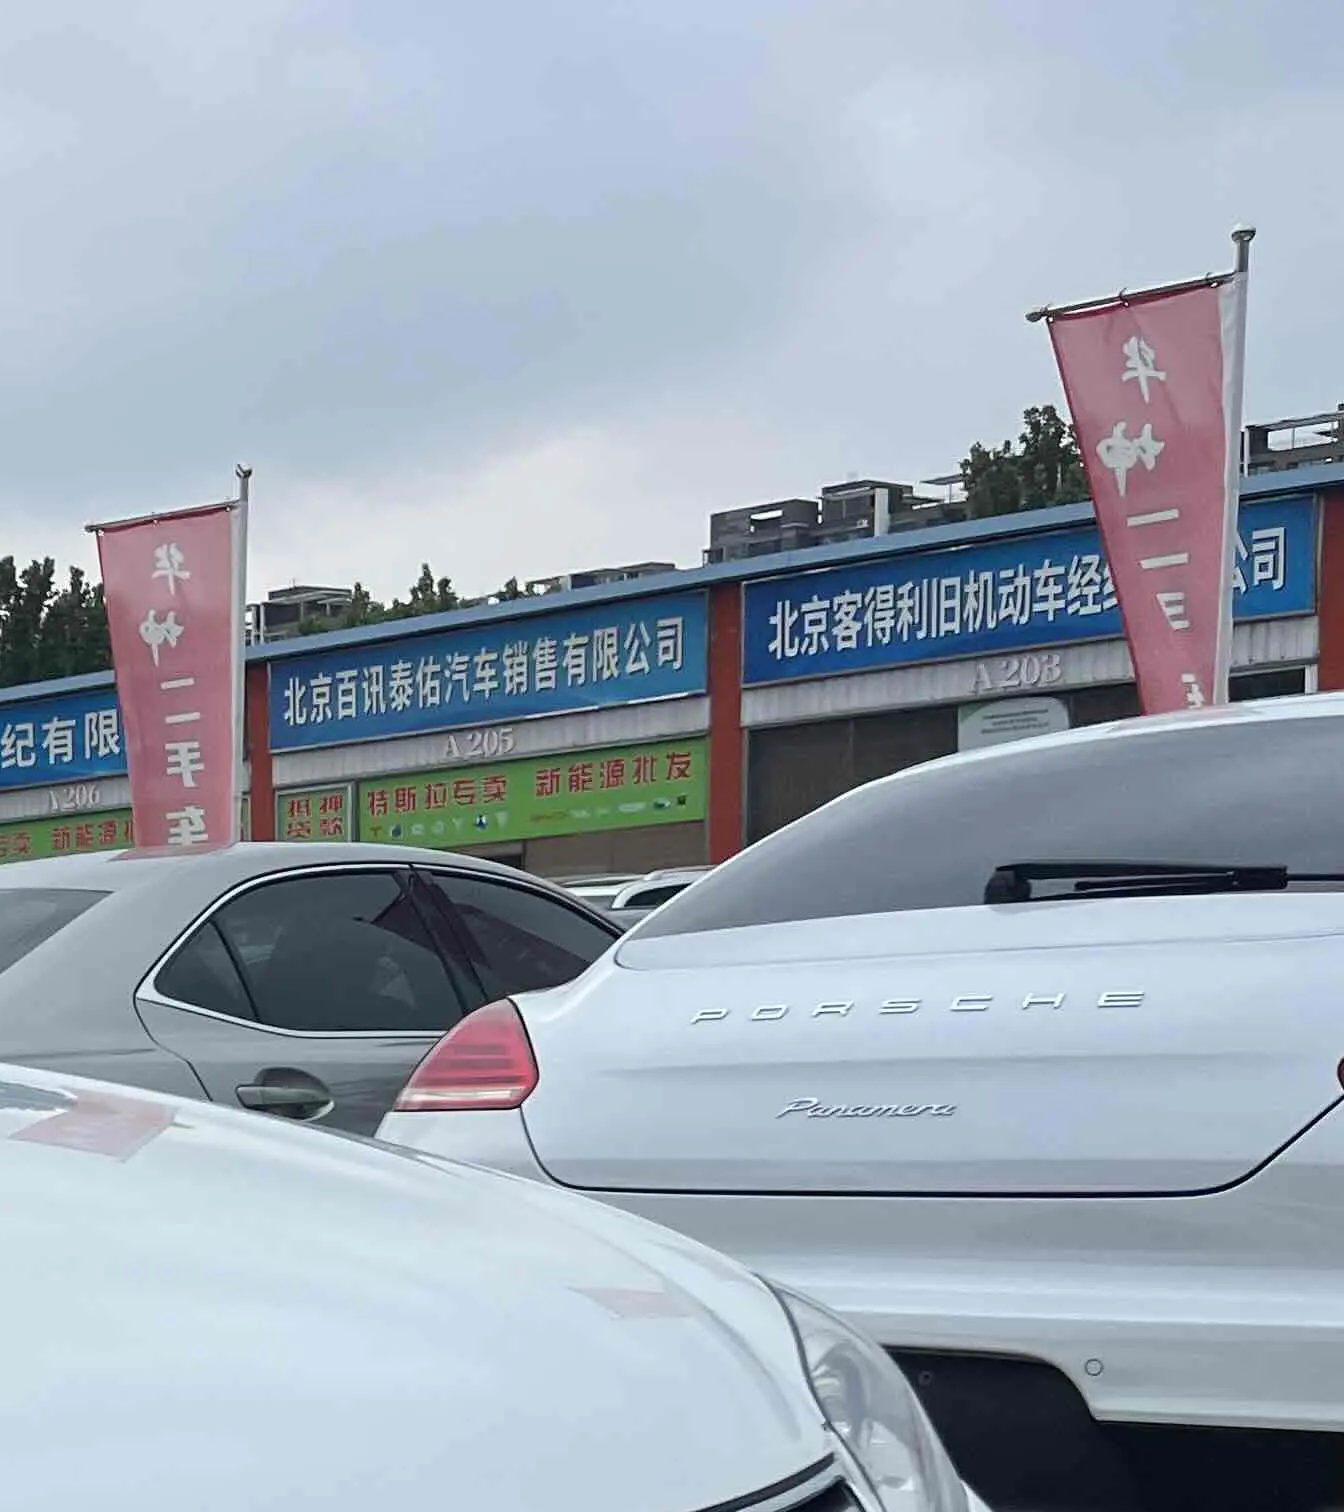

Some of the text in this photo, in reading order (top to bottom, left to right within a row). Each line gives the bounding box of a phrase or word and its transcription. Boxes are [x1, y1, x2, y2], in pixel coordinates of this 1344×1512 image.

[283, 615, 685, 728] 北京百讯泰佑汽车销售有限公司
[368, 751, 692, 817] 特斯拉专卖 新能源批发
[690, 990, 1145, 1024] PORSCHE
[776, 1097, 957, 1119] Panamera
